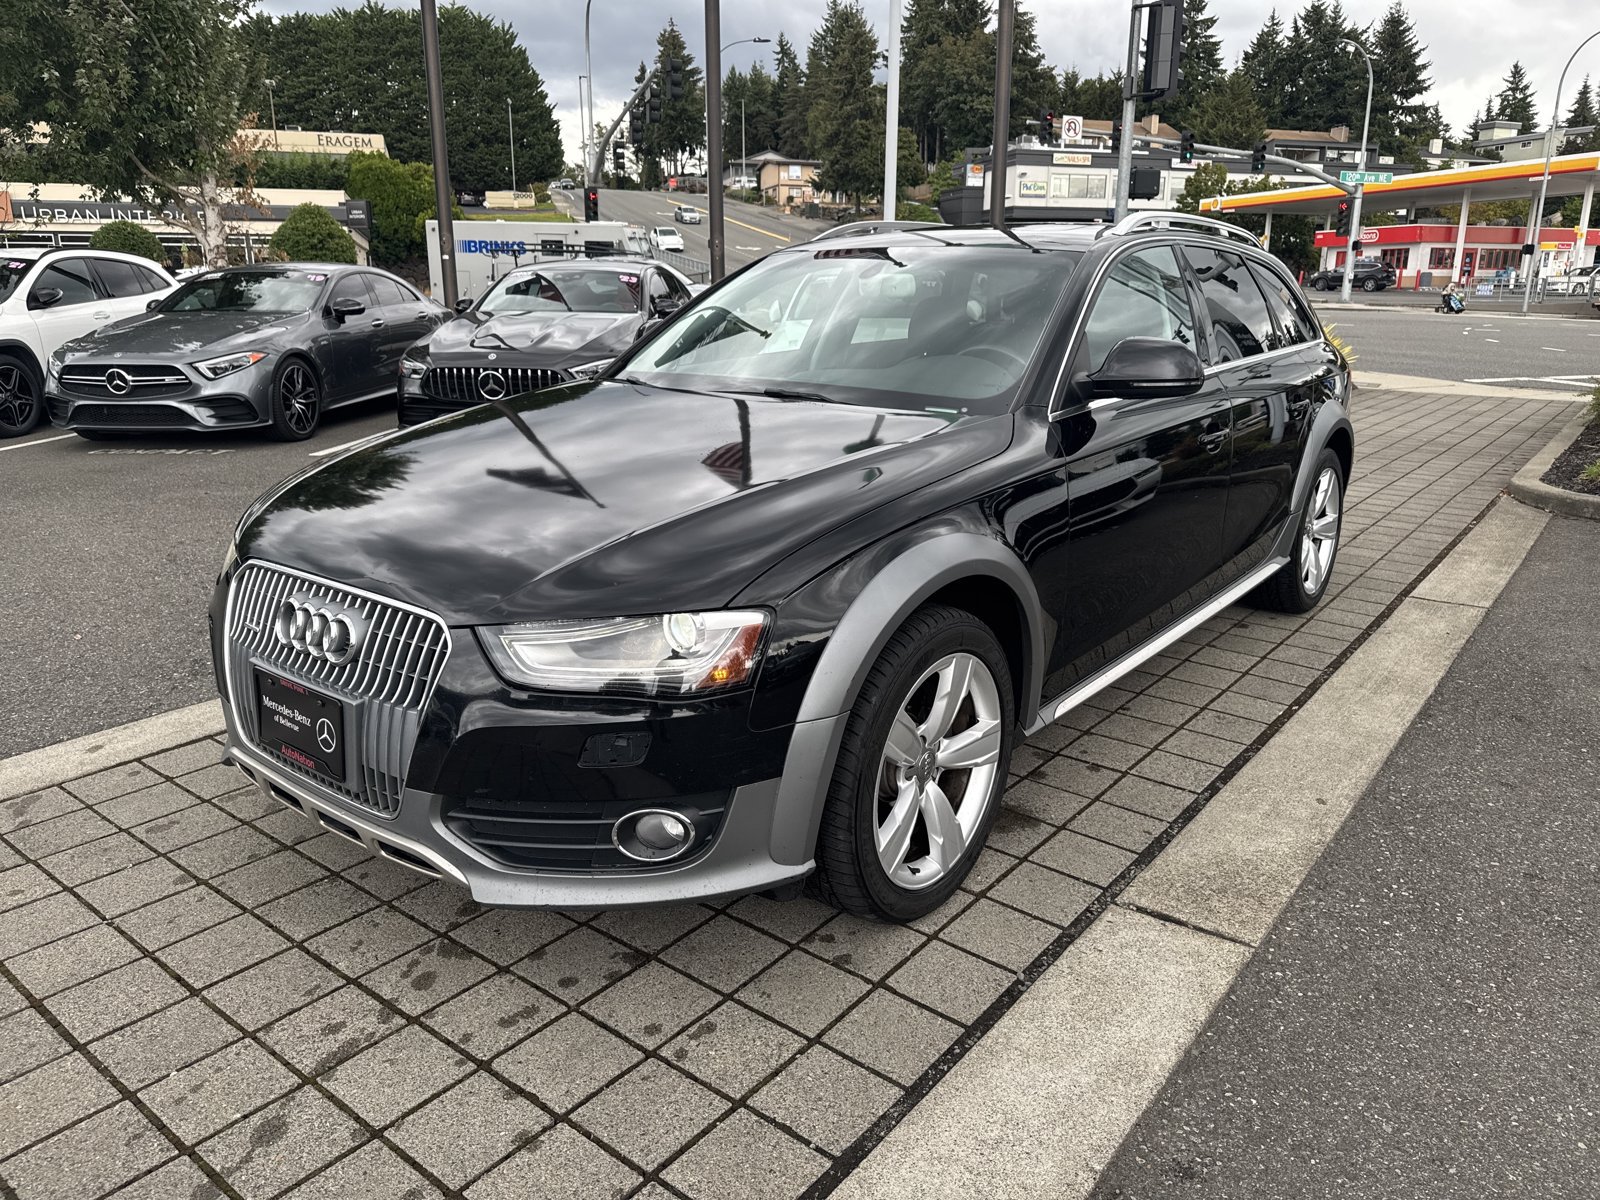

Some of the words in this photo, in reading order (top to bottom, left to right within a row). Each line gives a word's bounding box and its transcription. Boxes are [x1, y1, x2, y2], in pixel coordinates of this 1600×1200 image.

[1346, 172, 1360, 182] 120th
[1364, 173, 1376, 183] Ave
[1379, 174, 1388, 183] NE
[20, 206, 101, 224] URBAN
[262, 694, 312, 727] Mercedes-Benz
[273, 714, 279, 723] of
[279, 716, 300, 732] Bellevue
[281, 744, 316, 769] AutoNation
